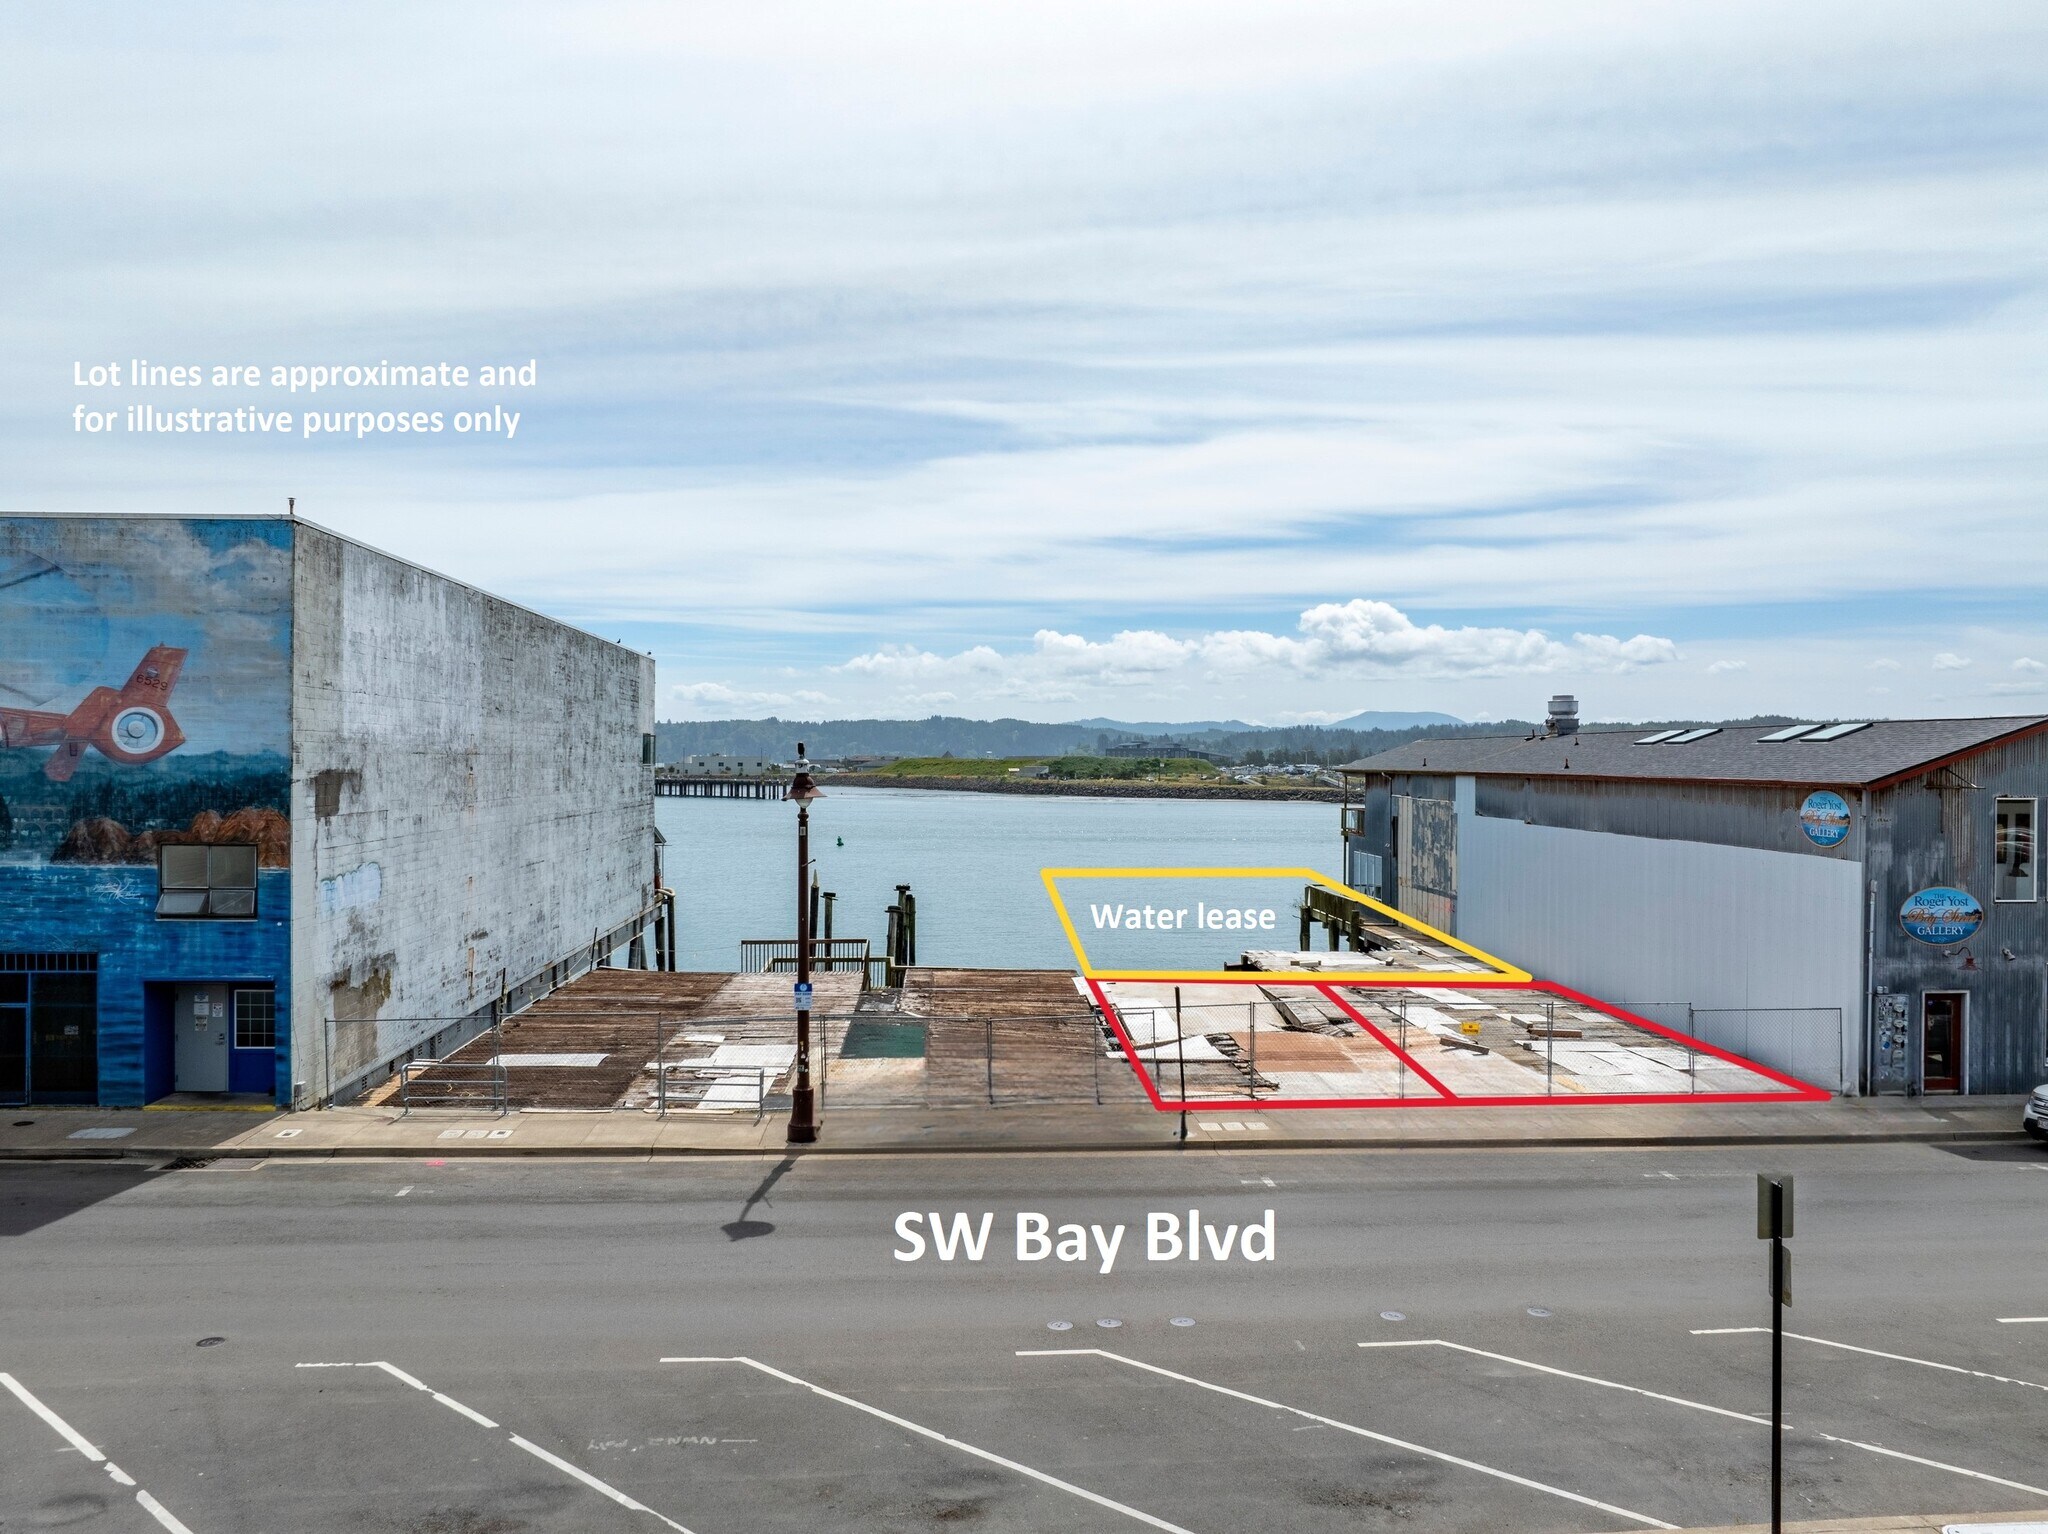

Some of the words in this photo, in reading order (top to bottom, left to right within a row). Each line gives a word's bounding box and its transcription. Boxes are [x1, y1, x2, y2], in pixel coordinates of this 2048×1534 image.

[136, 674, 168, 691] 6529
[1808, 798, 1827, 811] Roger
[1827, 800, 1842, 811] Yost
[1810, 828, 1840, 839] GALLERY
[1914, 895, 1947, 909] Roger
[1947, 895, 1969, 907] Yost
[1917, 926, 1965, 936] GALLERY
